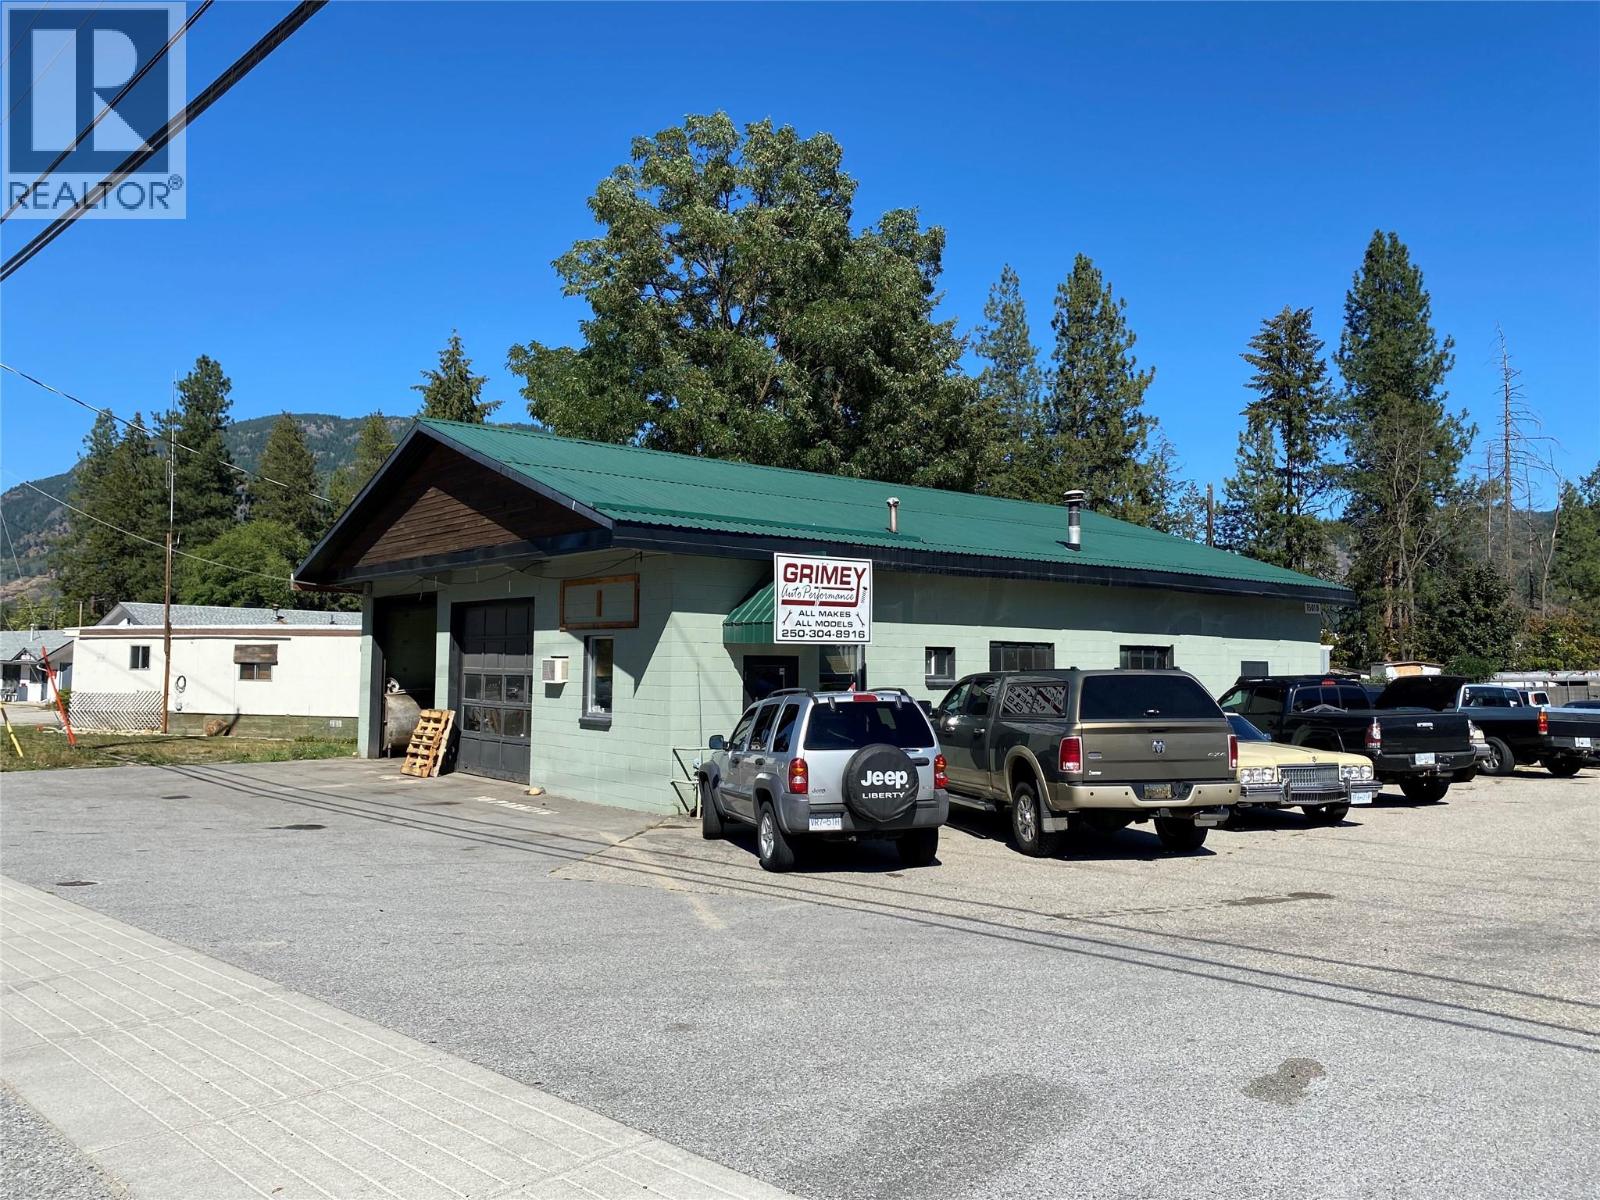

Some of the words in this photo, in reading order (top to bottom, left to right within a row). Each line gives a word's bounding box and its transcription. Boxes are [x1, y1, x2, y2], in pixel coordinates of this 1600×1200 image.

[783, 563, 867, 586] GRIMEY
[781, 584, 802, 599] Auto
[803, 585, 854, 601] Performance
[818, 610, 851, 618] MAKES
[815, 620, 854, 628] MODELS
[781, 629, 866, 639] 250-304-8916
[862, 791, 906, 799] LIBERTY
